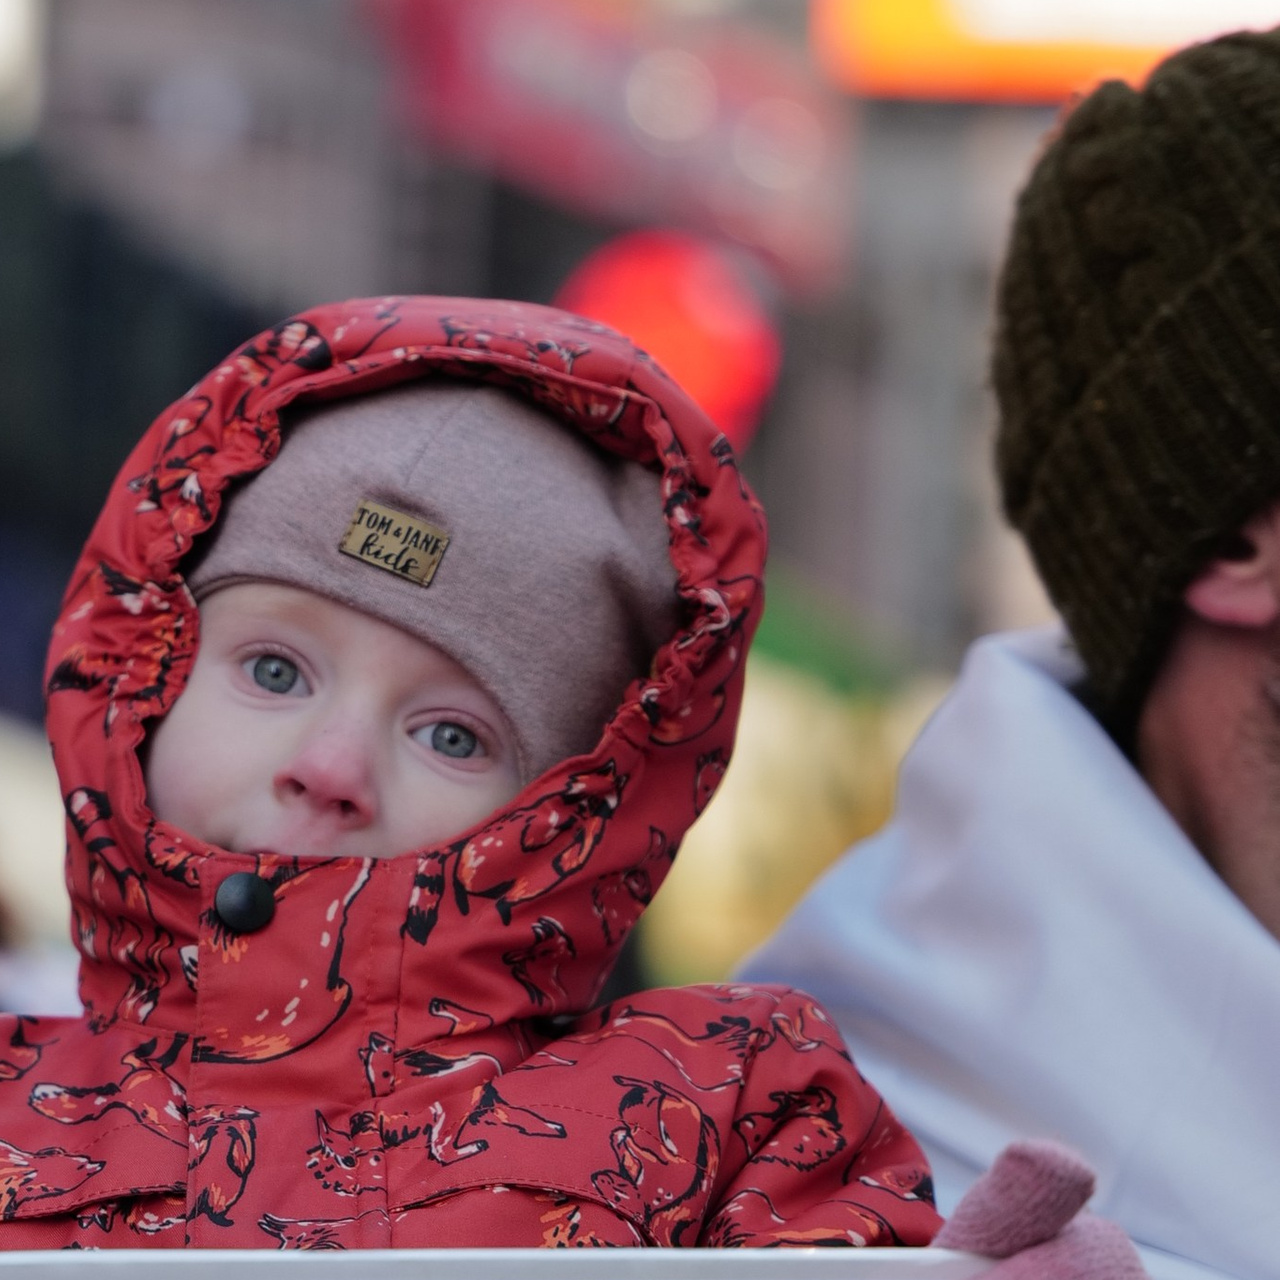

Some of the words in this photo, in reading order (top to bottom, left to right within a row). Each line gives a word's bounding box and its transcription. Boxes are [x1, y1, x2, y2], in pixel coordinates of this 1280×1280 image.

[355, 507, 395, 536] TOM
[392, 526, 402, 538] &
[359, 532, 419, 574] kids
